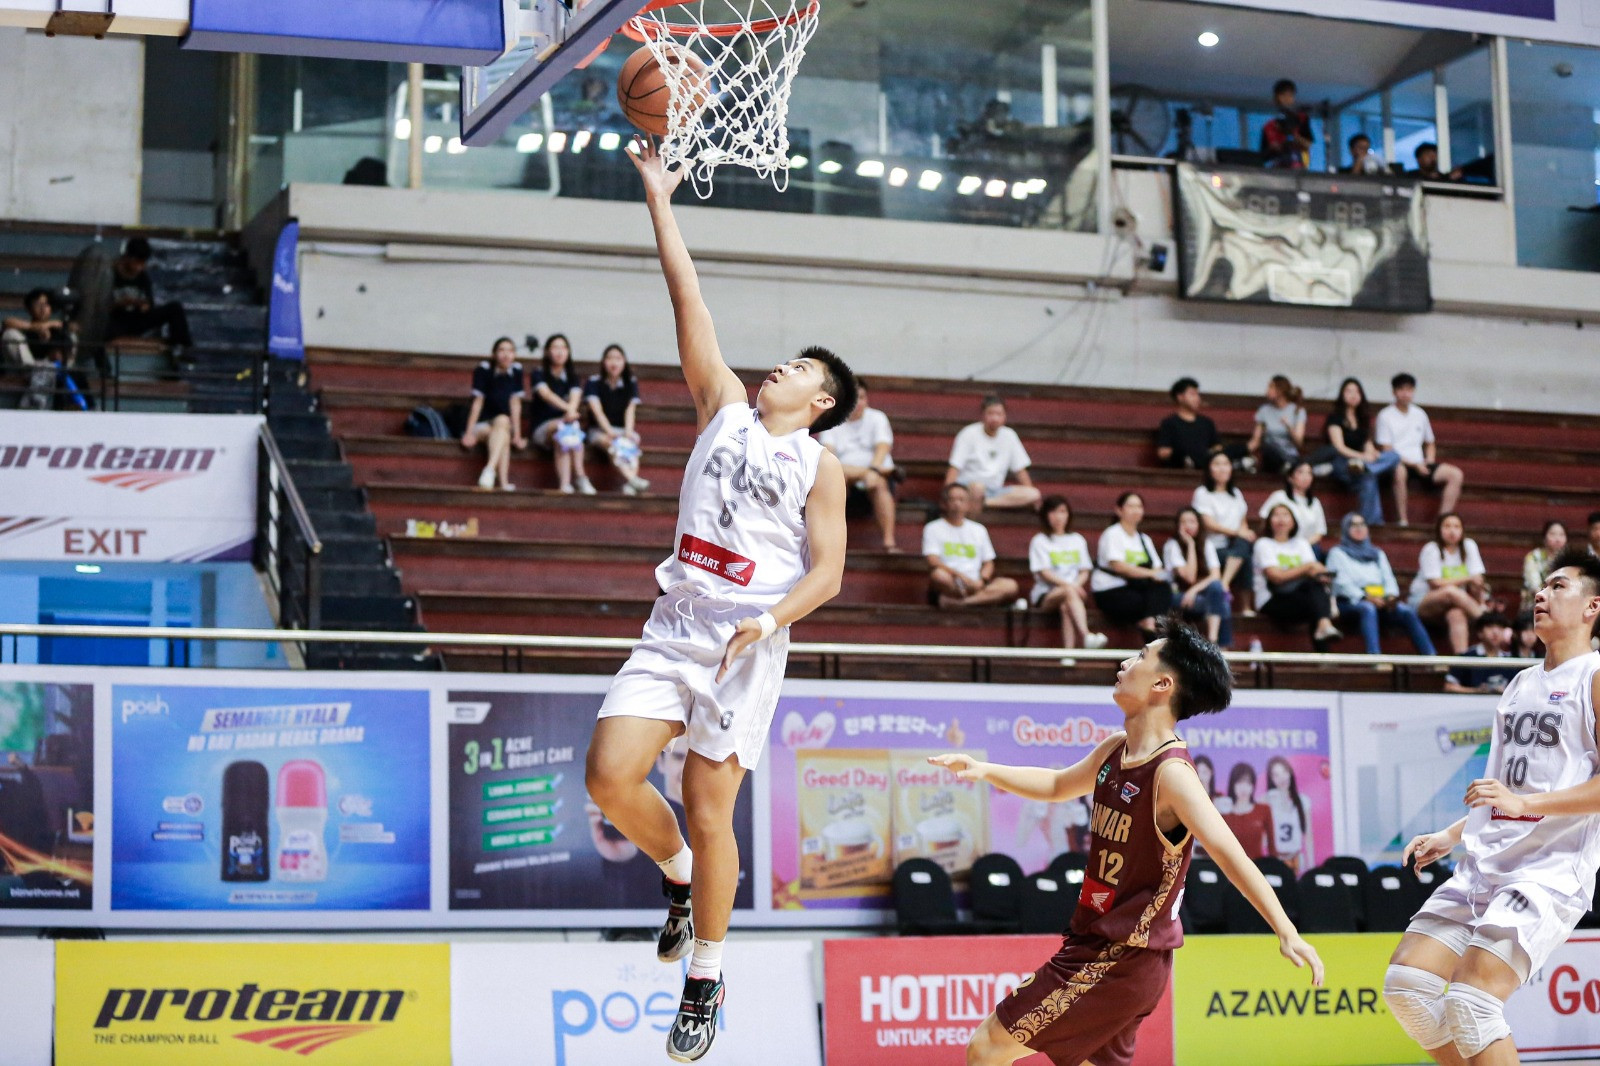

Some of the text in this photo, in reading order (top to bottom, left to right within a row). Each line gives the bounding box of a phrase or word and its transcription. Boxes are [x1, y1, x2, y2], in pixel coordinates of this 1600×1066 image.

[64, 529, 147, 555] EXIT
[122, 693, 170, 723] posh
[1016, 719, 1073, 743] Good
[804, 769, 887, 791] Good Day
[1506, 755, 1528, 788] 10
[1279, 822, 1293, 843] 3
[1098, 848, 1124, 885] 12
[93, 983, 405, 1028] proteam
[552, 954, 725, 1066] pos
[860, 975, 944, 1022] HOT
[94, 1033, 219, 1044] THE CHAMPION BALL
[877, 1028, 932, 1047] UNTUK
